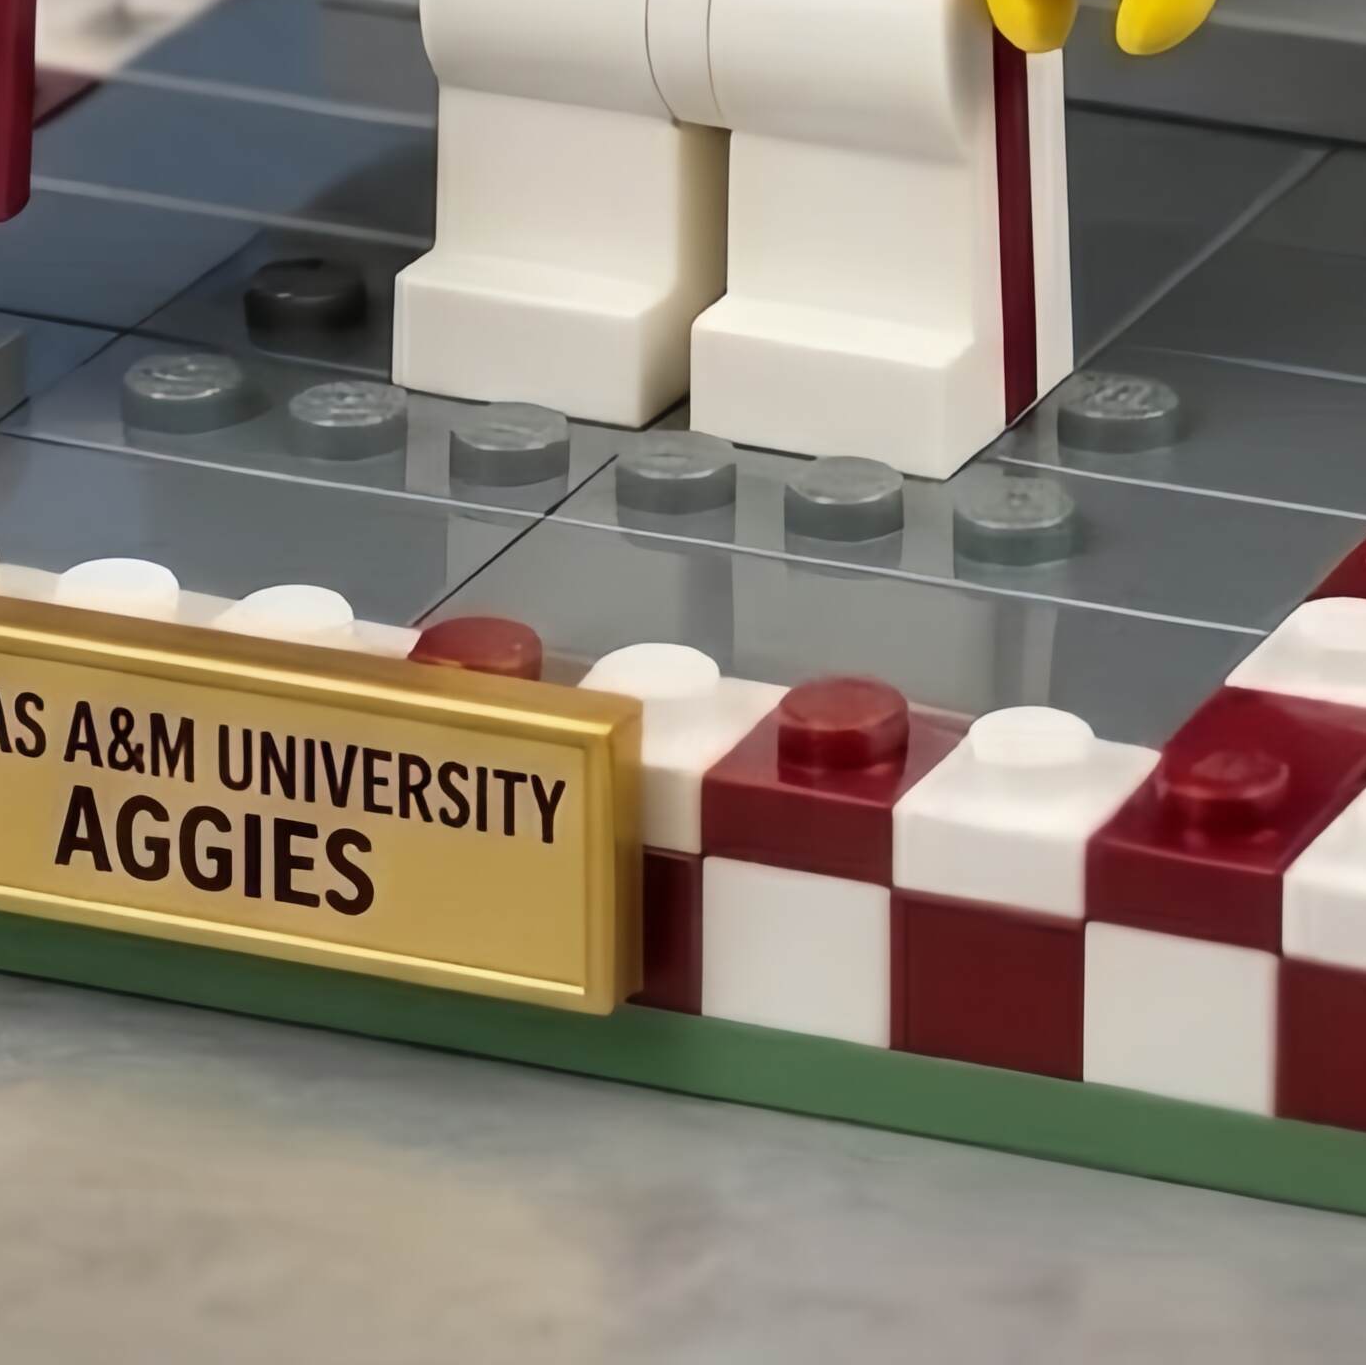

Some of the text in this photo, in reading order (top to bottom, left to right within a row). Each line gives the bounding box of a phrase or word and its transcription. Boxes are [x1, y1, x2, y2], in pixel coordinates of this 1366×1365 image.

[63, 700, 195, 783] A&M
[218, 724, 566, 844] UNIVERSITY
[54, 784, 375, 916] AGGIES
